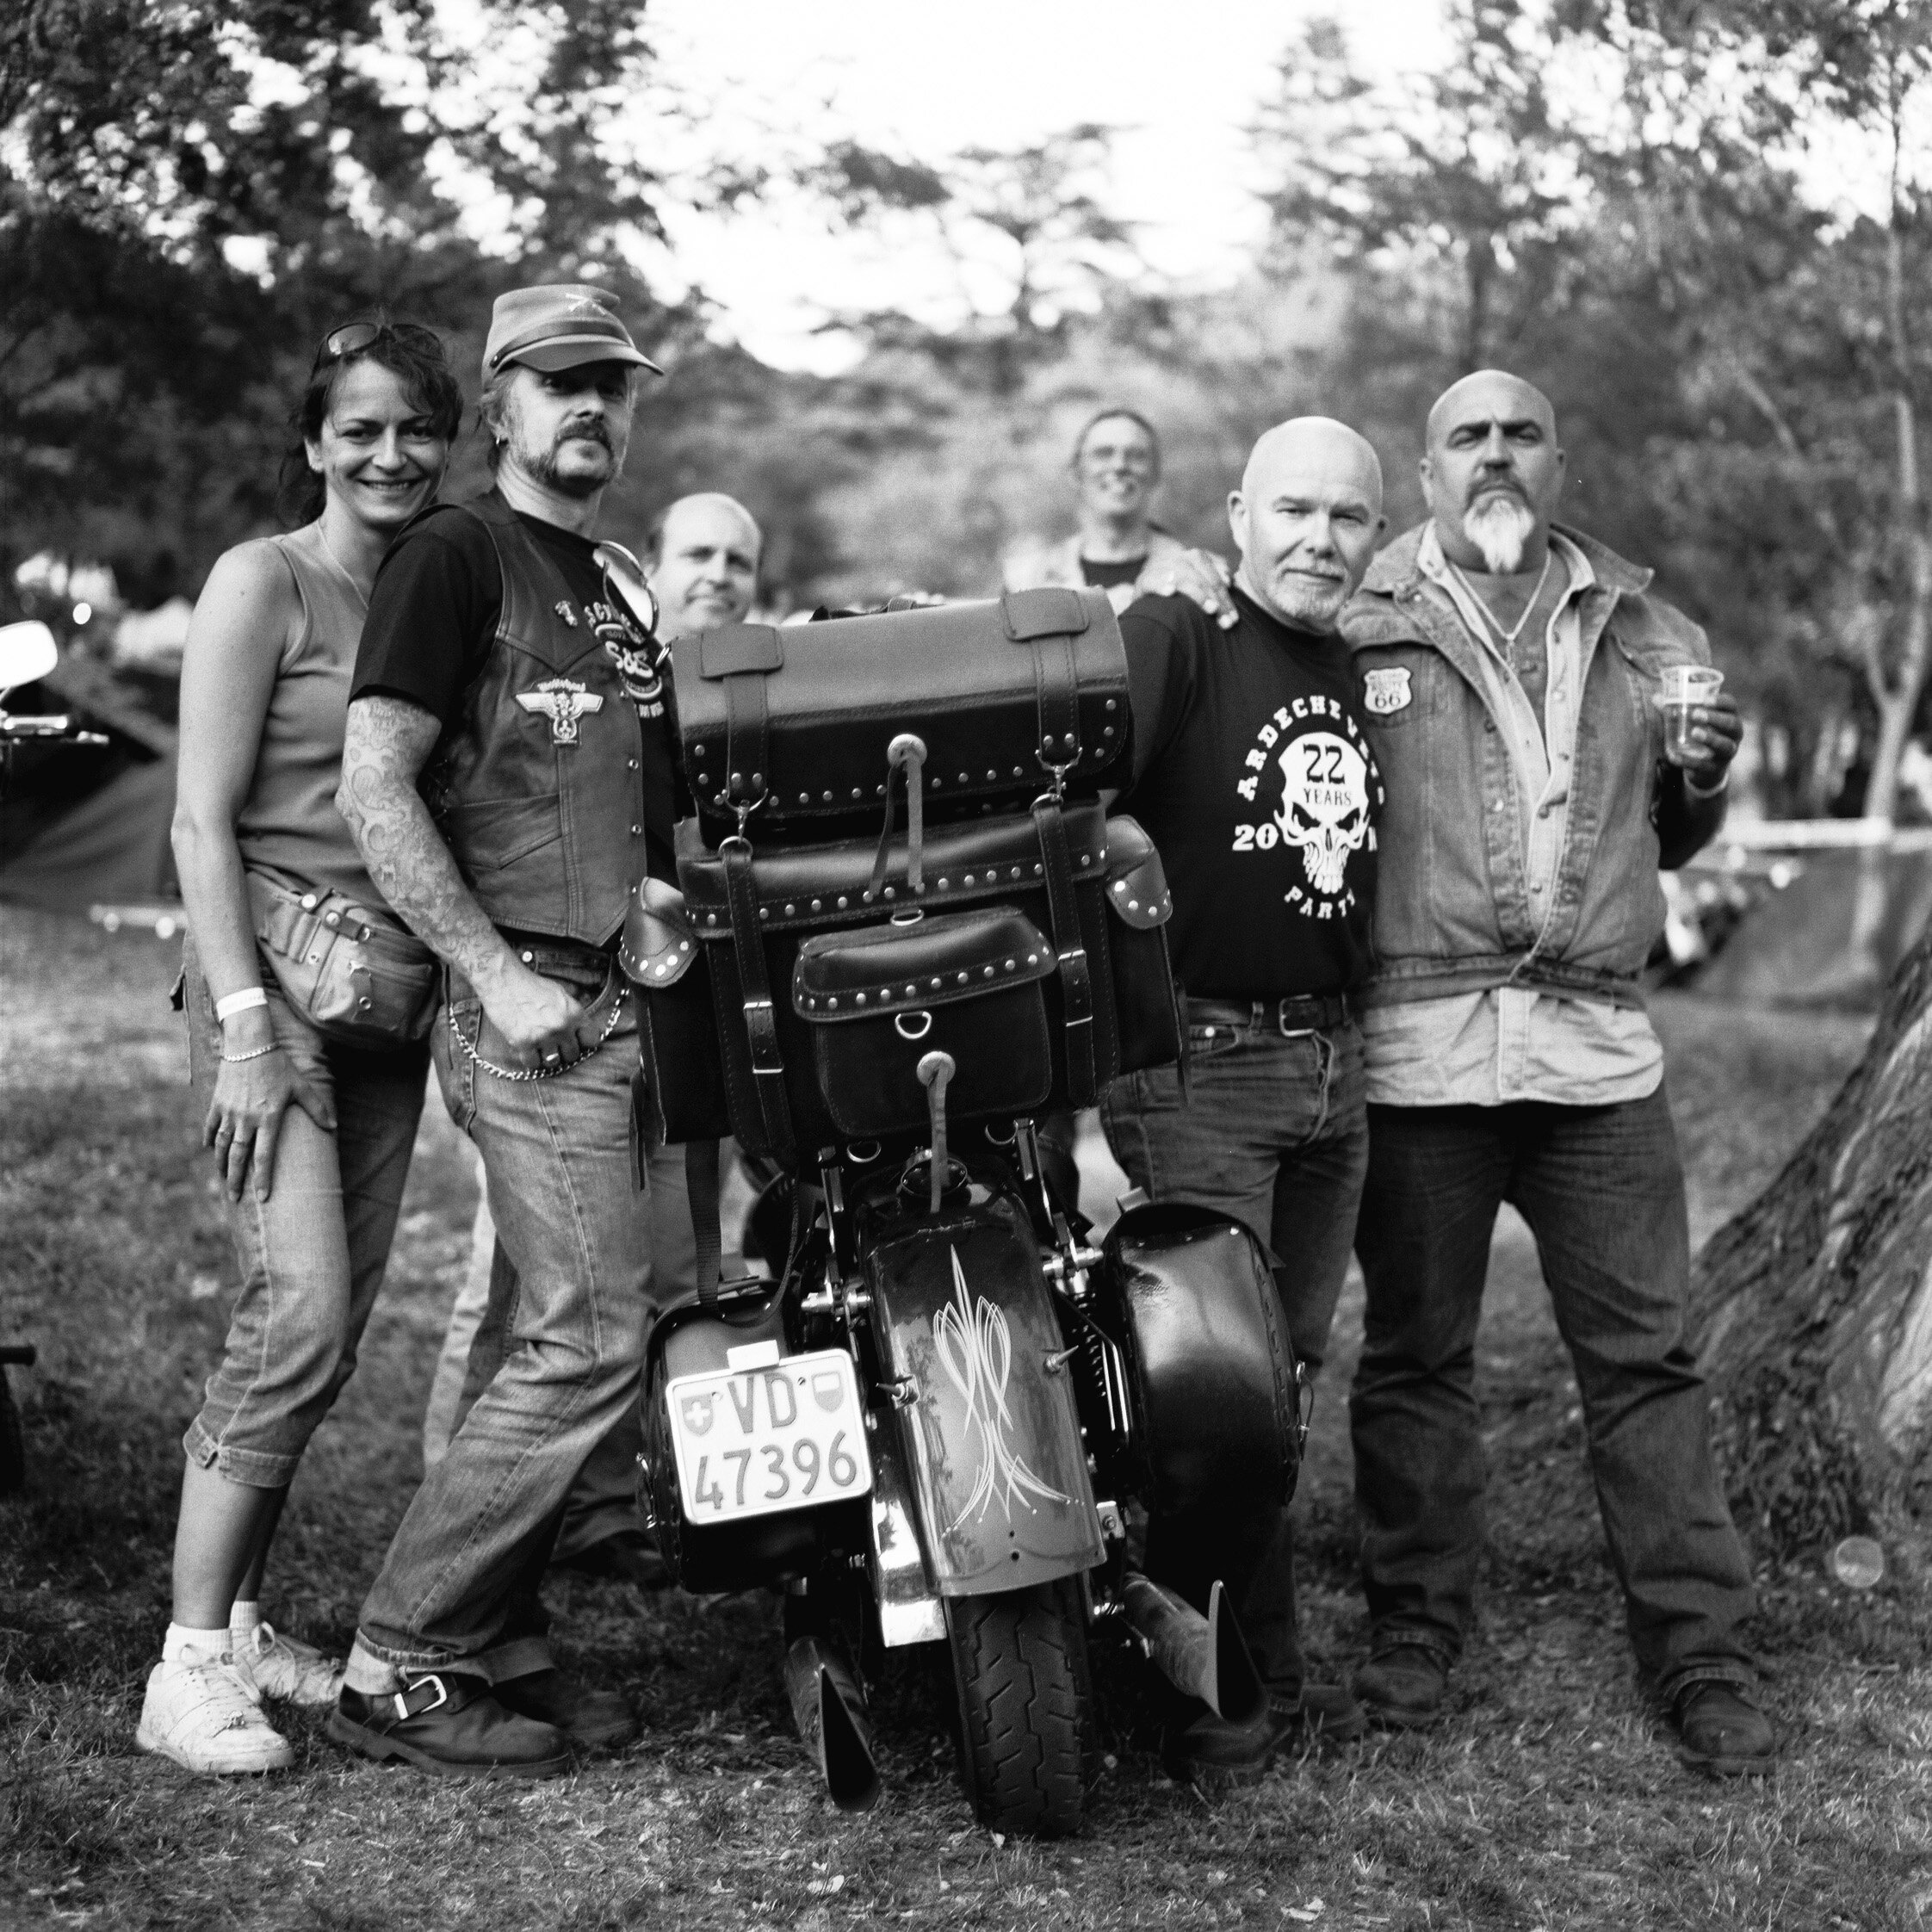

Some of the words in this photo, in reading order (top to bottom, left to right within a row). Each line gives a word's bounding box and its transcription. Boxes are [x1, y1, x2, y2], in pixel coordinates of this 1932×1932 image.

[1375, 693, 1401, 709] 66
[1303, 743, 1346, 784] 22
[1303, 788, 1352, 806] YEARS
[1232, 822, 1279, 851] 20
[727, 1372, 797, 1434] VD
[695, 1429, 858, 1509] 47396
